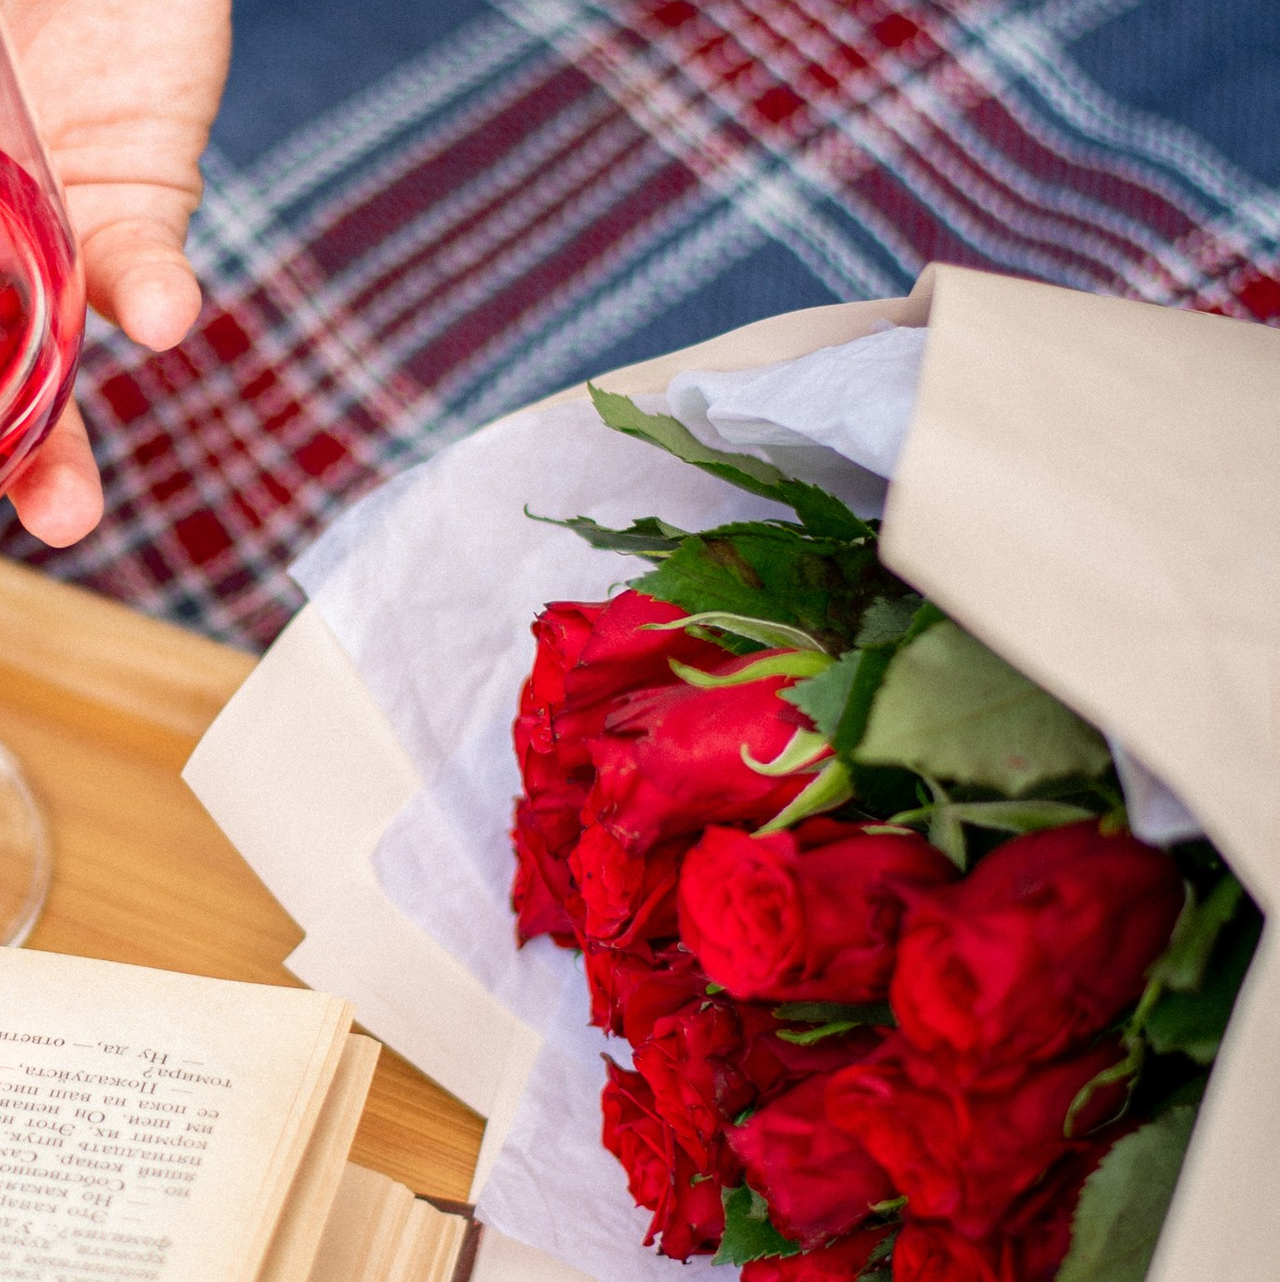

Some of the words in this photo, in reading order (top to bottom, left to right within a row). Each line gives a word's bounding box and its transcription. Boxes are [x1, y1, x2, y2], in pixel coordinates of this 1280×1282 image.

[137, 1048, 168, 1065] Ну
[142, 1066, 232, 1088] томира?
[49, 1089, 91, 1102] ваш
[103, 1095, 127, 1107] на
[138, 1100, 187, 1114] пока
[196, 1109, 220, 1119] ее
[74, 1108, 106, 1123] Он
[27, 1118, 76, 1136] Этот
[185, 1122, 213, 1134] им
[132, 1132, 208, 1150] кормит
[78, 1142, 202, 1166] пятнадцать
